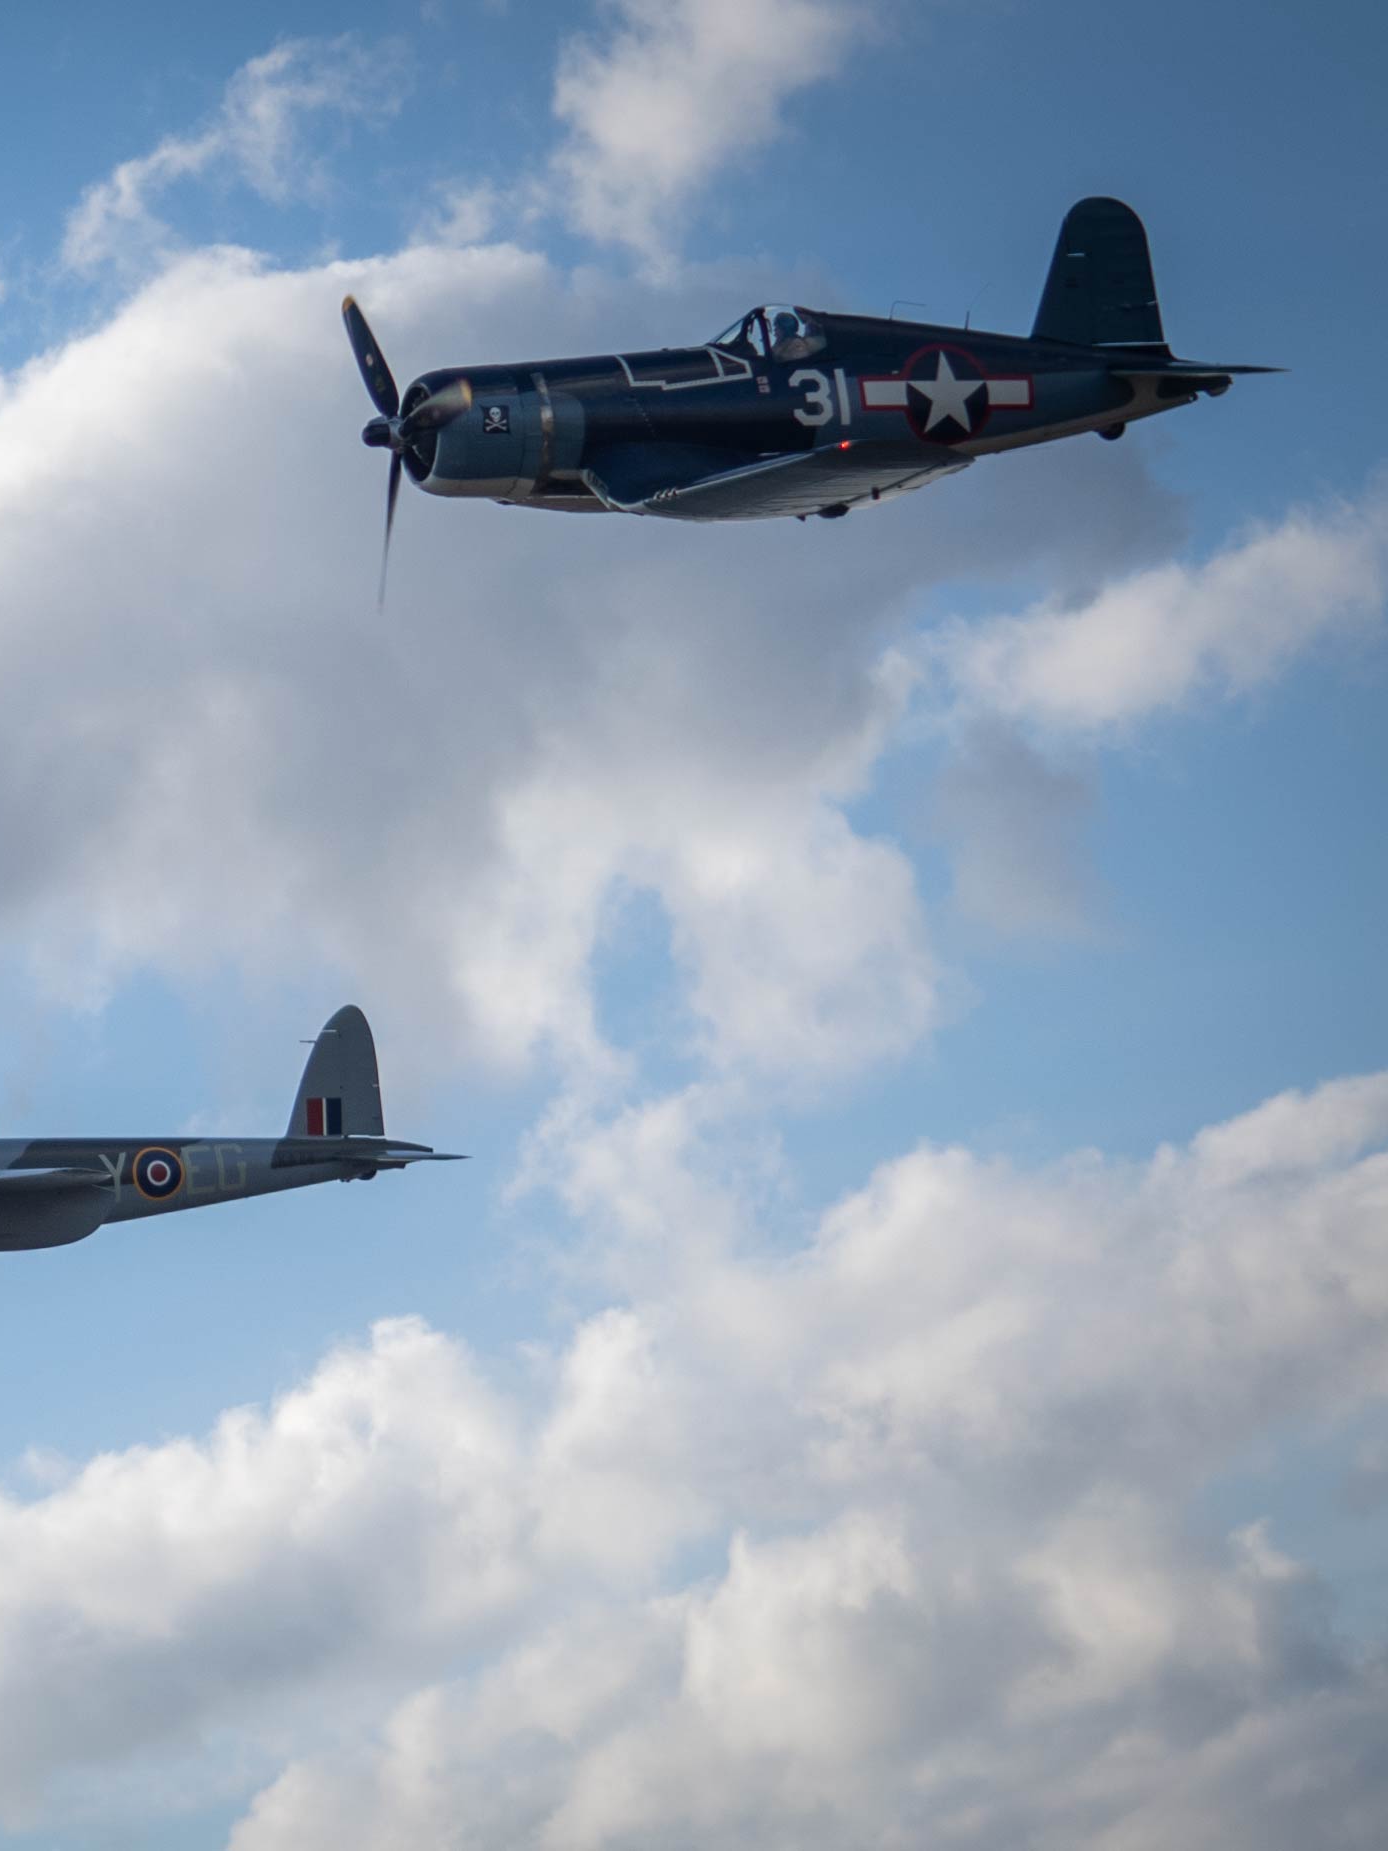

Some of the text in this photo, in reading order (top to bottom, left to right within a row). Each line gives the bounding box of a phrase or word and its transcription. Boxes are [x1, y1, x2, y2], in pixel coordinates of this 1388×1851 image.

[788, 368, 851, 426] 31
[98, 1144, 246, 1201] Y EG
